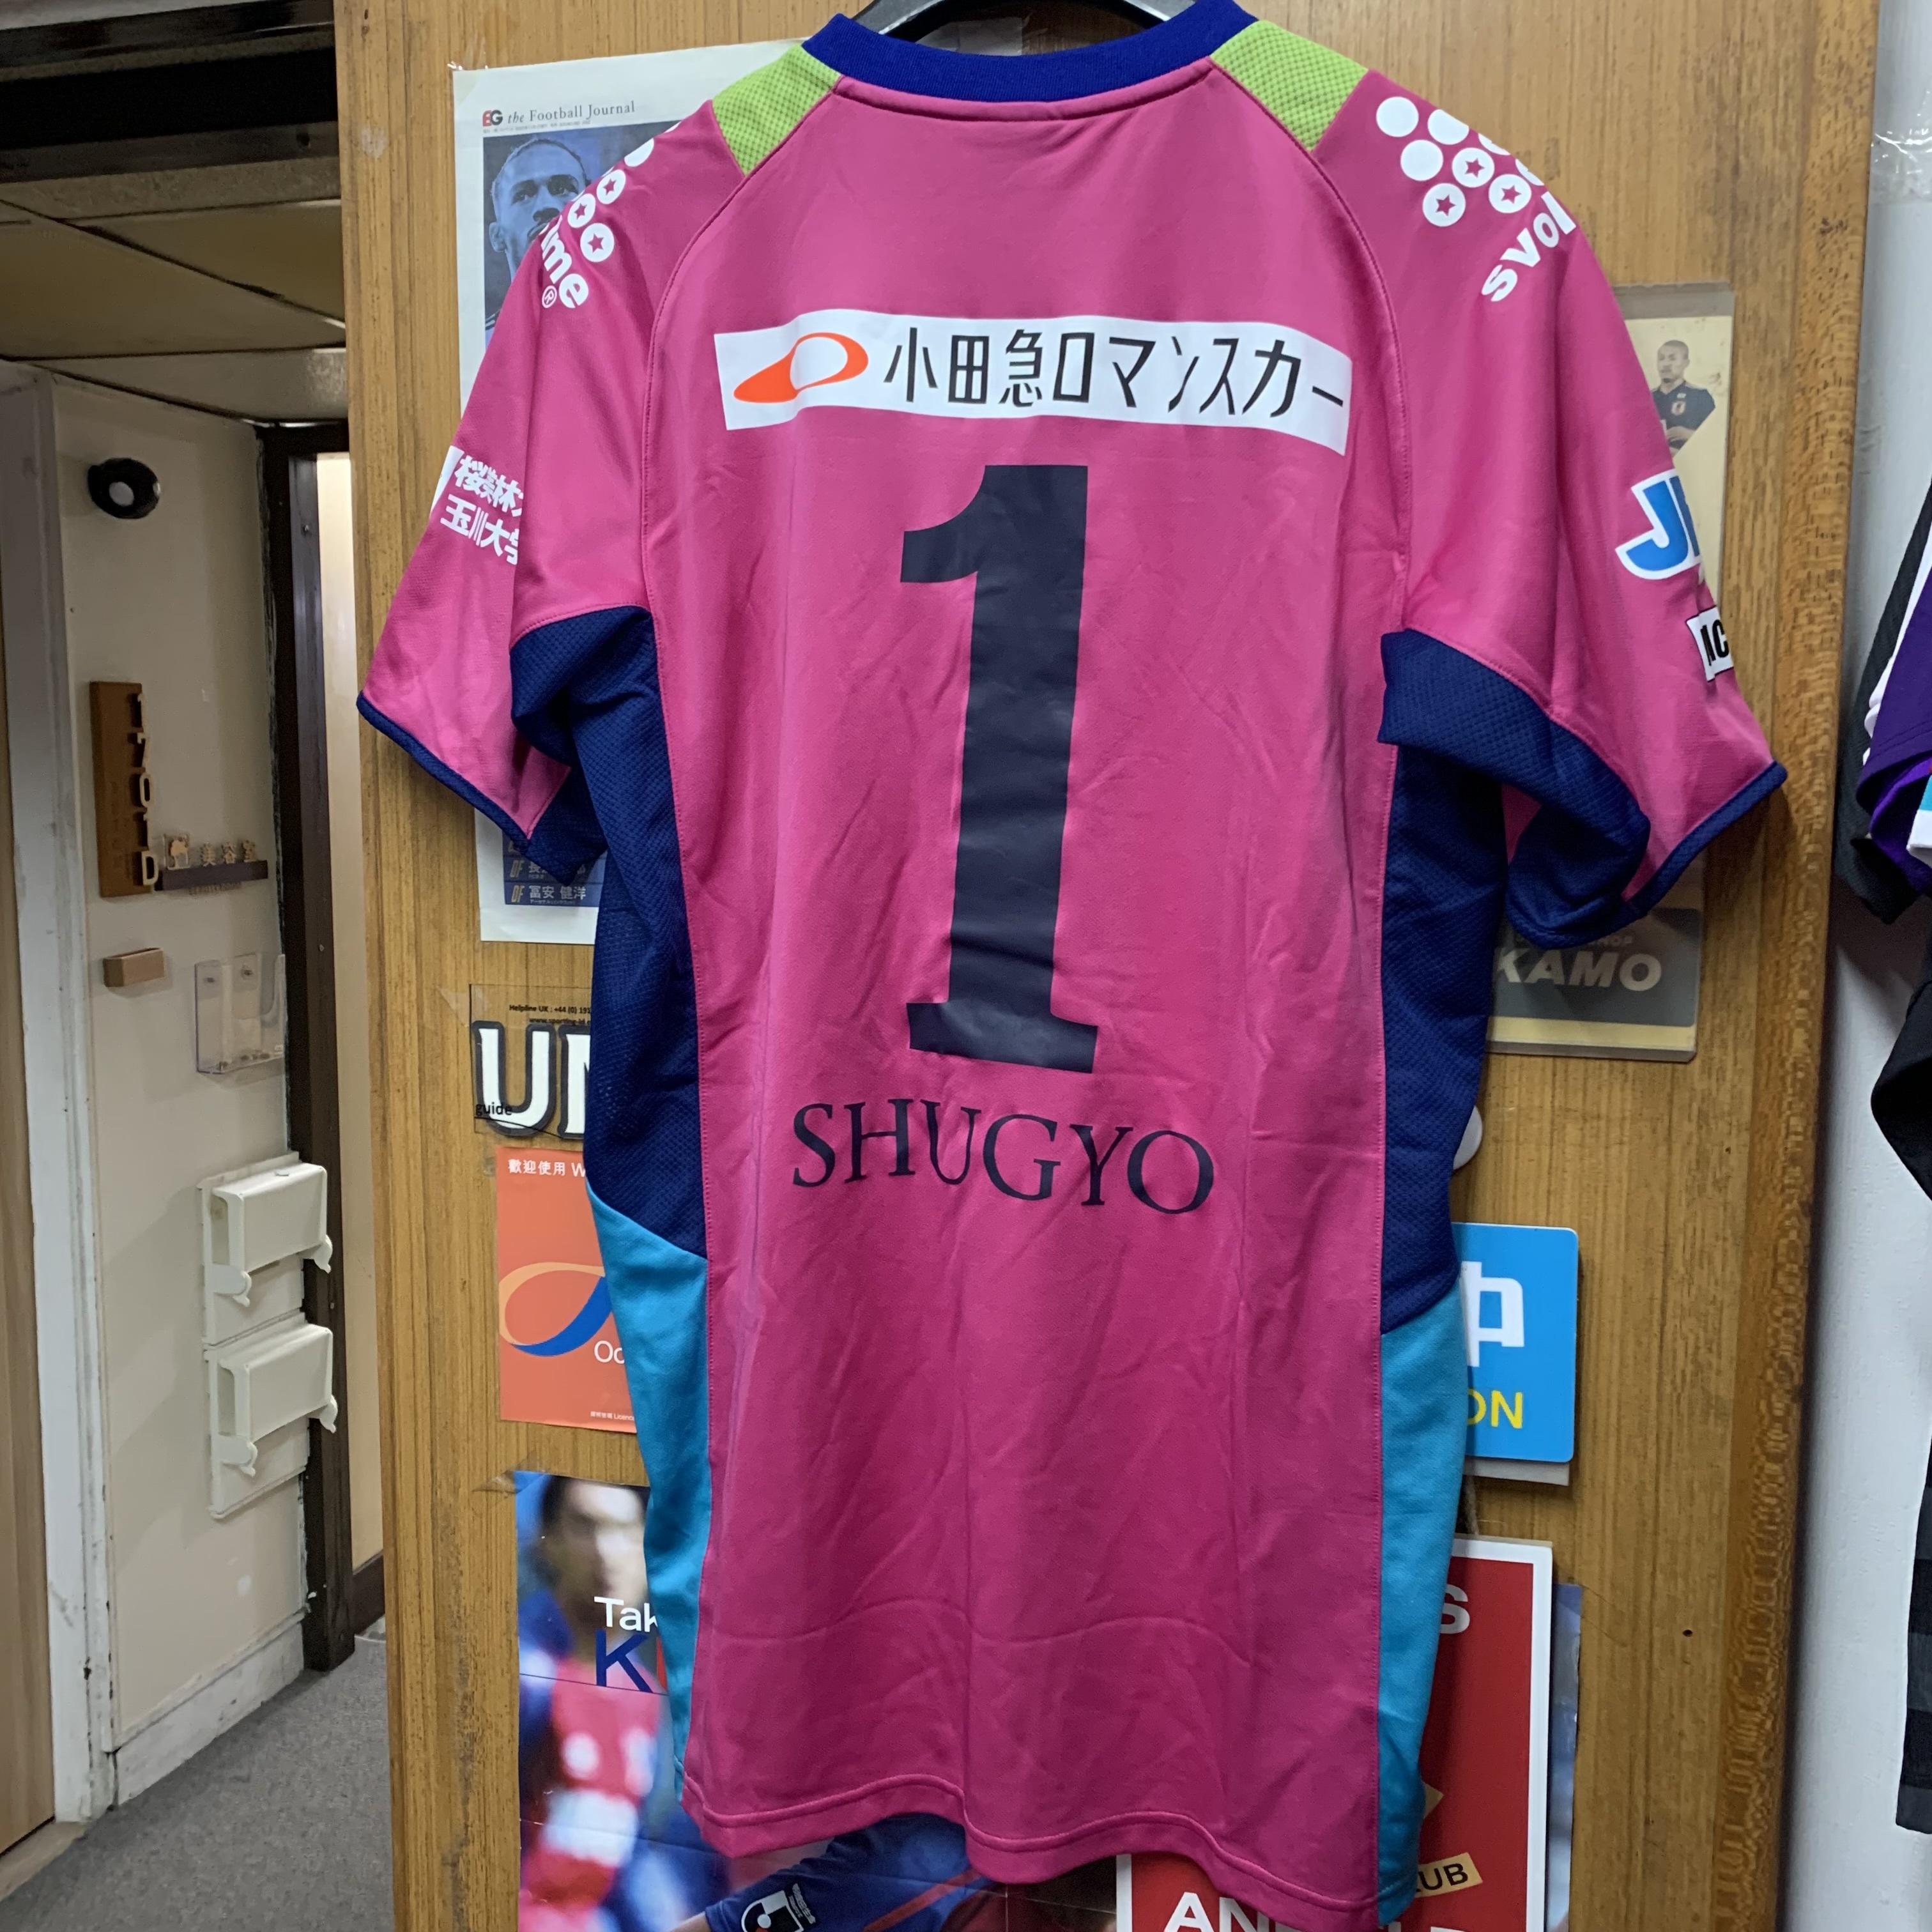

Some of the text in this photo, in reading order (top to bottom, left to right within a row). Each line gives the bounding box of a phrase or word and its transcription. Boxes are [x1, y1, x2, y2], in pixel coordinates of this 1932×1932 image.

[508, 111, 525, 124] the
[530, 105, 582, 122] Football
[586, 100, 635, 119] Journal
[884, 326, 1345, 418] 小田急ロマンスカー
[900, 464, 1099, 1074] 1
[475, 1101, 512, 1116] guide
[792, 1098, 1215, 1215] SHUGYO
[1416, 1863, 1469, 1892] UB
